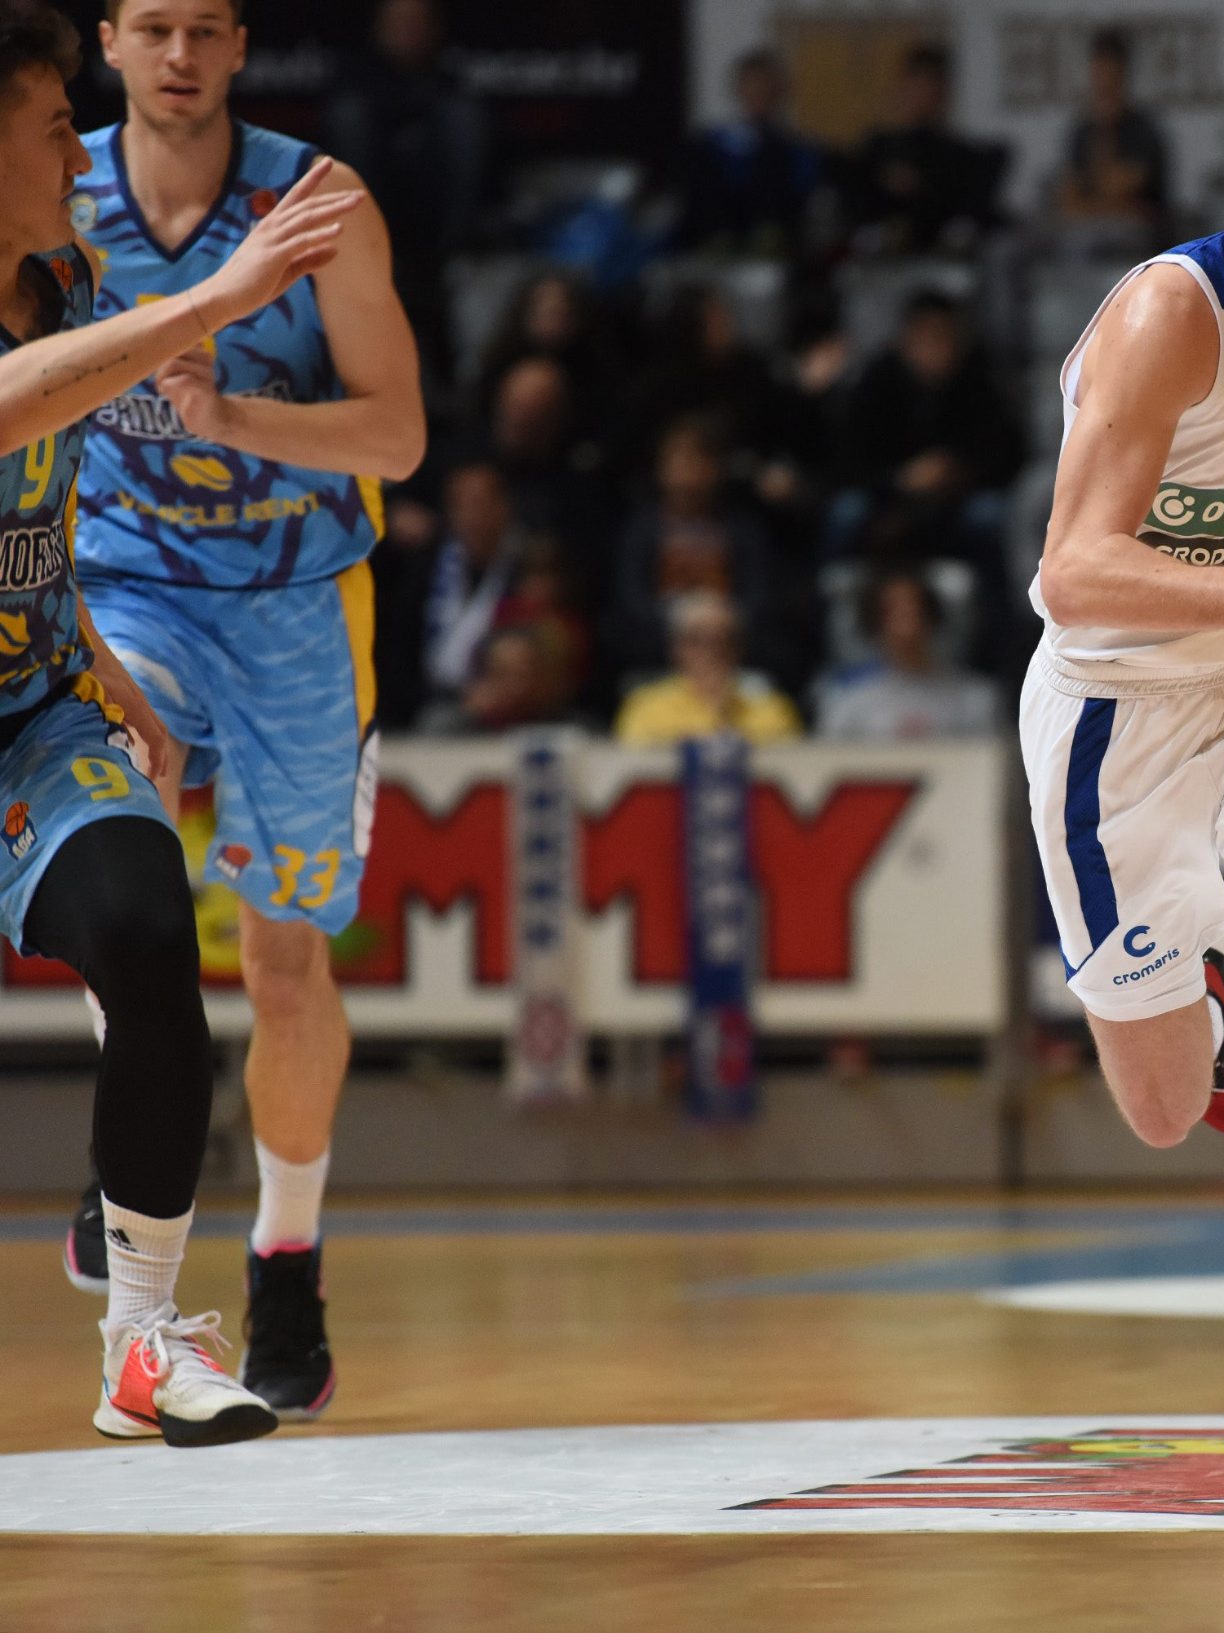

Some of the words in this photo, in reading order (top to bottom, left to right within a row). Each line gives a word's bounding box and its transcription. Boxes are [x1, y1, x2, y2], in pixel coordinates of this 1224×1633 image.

[18, 432, 55, 510] 9
[71, 757, 130, 801] 9
[11, 828, 36, 861] ABA
[270, 844, 341, 908] 33
[1114, 947, 1181, 985] cromaris
